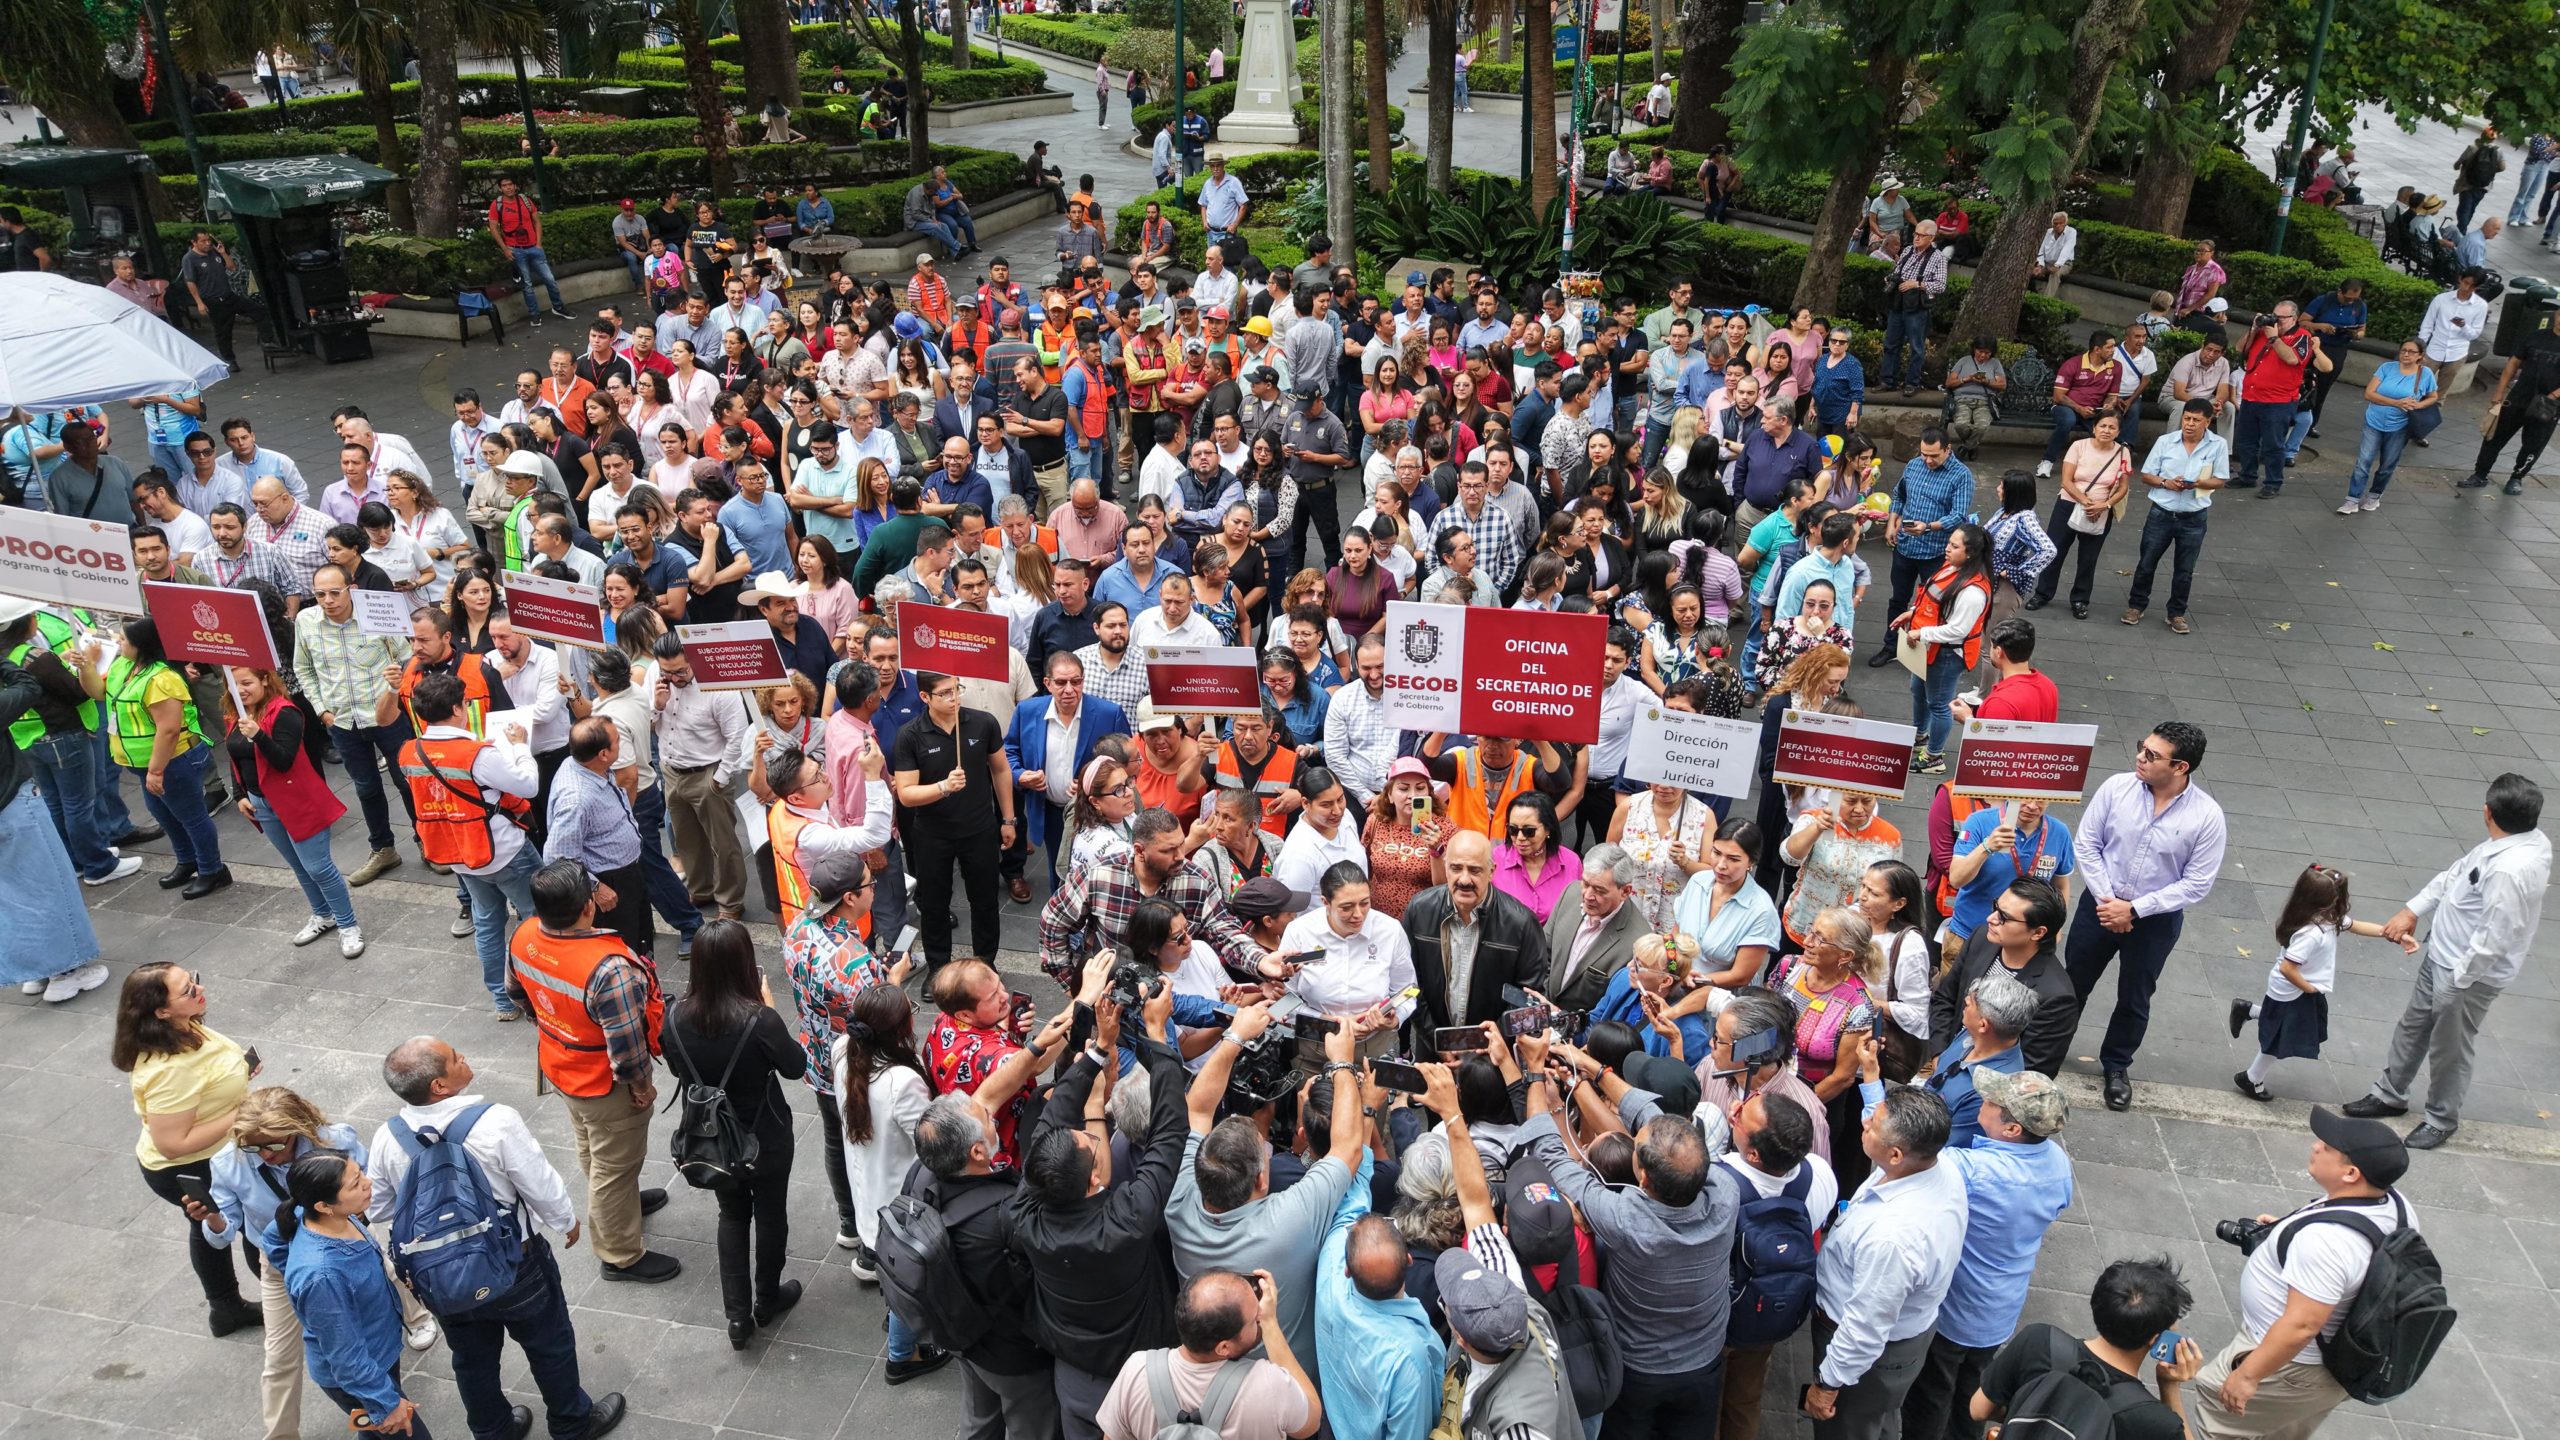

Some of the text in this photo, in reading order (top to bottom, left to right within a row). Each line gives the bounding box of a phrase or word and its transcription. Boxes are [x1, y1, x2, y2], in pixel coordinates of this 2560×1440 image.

[976, 462, 1009, 471] adidas
[0, 535, 127, 572] ROGOB
[0, 557, 129, 585] rograma de Gobierno
[517, 601, 586, 620] COORDINACIÓN DE
[514, 608, 595, 630] ATENCIÓN CIUDADANA
[192, 630, 234, 644] CGCS
[938, 629, 996, 645] SUBSEGOB
[938, 638, 988, 650] SUBSECRETARÍA
[186, 641, 224, 651] COORDINACIÓN
[194, 646, 231, 655] COMUNICACIÓN
[697, 643, 763, 654] SUBCOORDINACIÓN
[948, 645, 980, 653] GOBIERNO
[1505, 639, 1569, 655] OFICINA
[715, 652, 763, 661] INFORMACIÓN
[716, 660, 762, 669] VINCULACIÓN
[1521, 662, 1547, 675] DEL
[718, 669, 760, 677] CIUDADANA
[1170, 686, 1240, 694] ADMINISTRATIVA
[1384, 674, 1458, 692] SEGOB
[1476, 678, 1593, 698] SECRETARIO DE
[1398, 692, 1440, 702] Secretaría
[1393, 701, 1444, 711] de Gobierno
[1491, 699, 1574, 717] GOBIERNO
[1664, 729, 1728, 750] Dirección
[1665, 750, 1720, 769] General
[1781, 742, 1902, 766] JEFATURA DE LA OFICINA
[1973, 749, 2075, 763] ÓRGANO INTERNO DE
[1788, 752, 1894, 773] DE LA GOBERNADORA
[1965, 759, 2009, 768] CONTROL
[2027, 762, 2040, 770] LA
[2042, 763, 2080, 772] OFIGOB
[1662, 769, 1714, 788] Jurídica
[2005, 770, 2018, 778] LA
[2020, 771, 2061, 780] PROGOB
